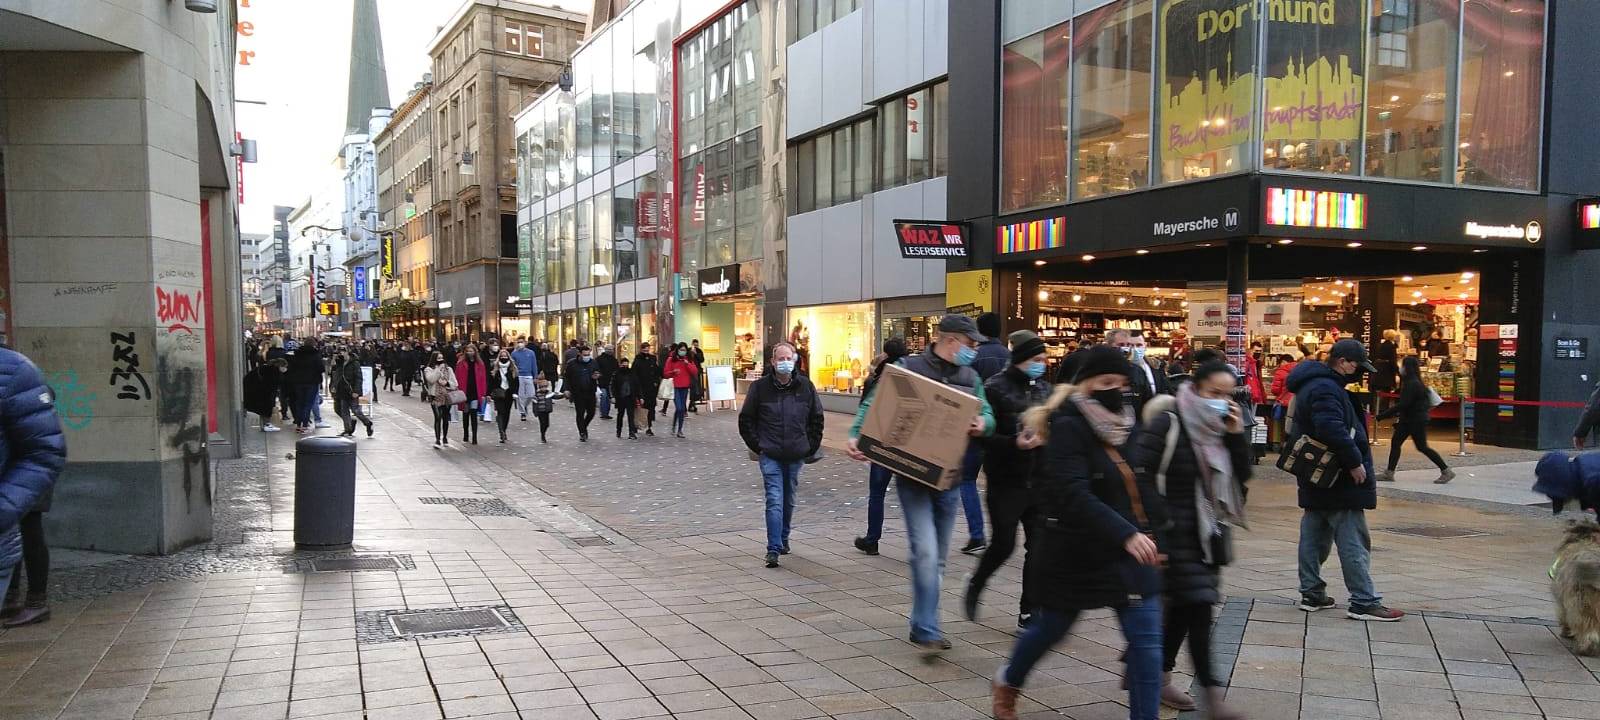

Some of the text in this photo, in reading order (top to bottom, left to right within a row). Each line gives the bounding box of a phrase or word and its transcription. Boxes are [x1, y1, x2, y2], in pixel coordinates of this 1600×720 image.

[1198, 0, 1335, 42] Dortmund
[1153, 216, 1219, 237] Mayersche
[901, 229, 963, 244] WAZ WR
[904, 246, 967, 256] LESERSERVICE
